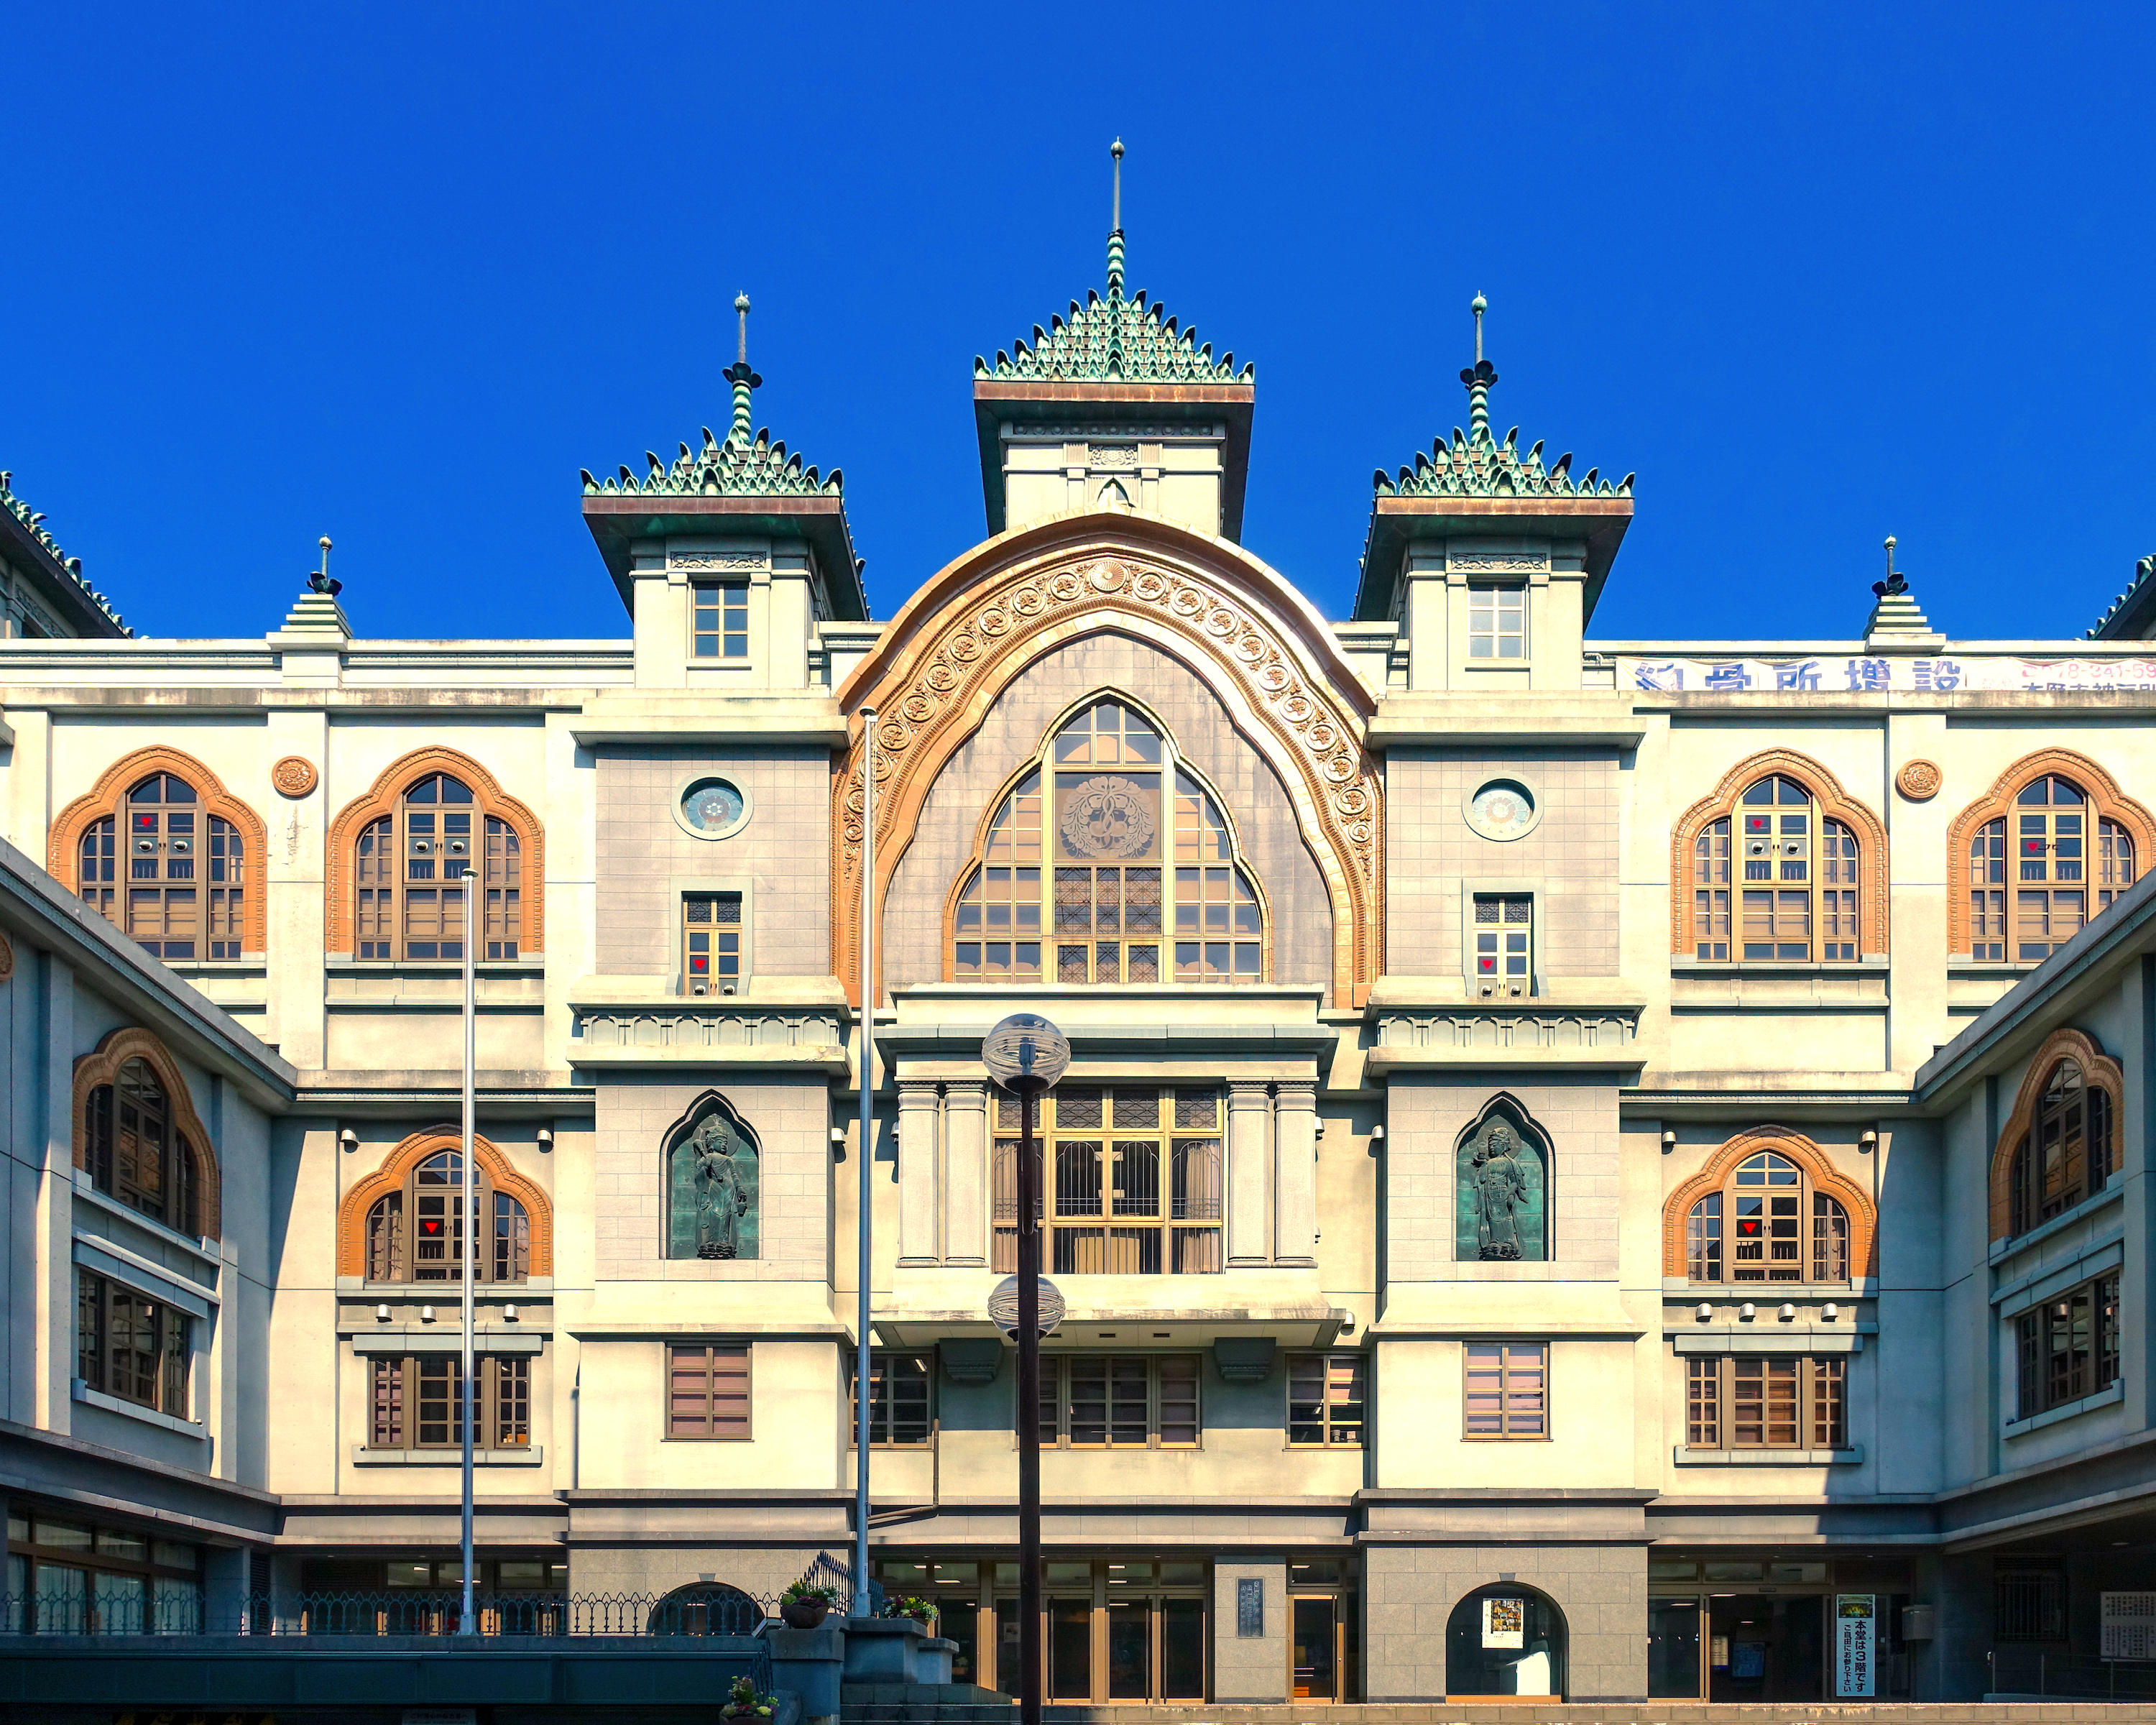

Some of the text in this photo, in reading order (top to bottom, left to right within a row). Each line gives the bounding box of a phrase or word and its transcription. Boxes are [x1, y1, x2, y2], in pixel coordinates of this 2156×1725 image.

[1855, 1620, 1866, 1692] 本堂は3階です
